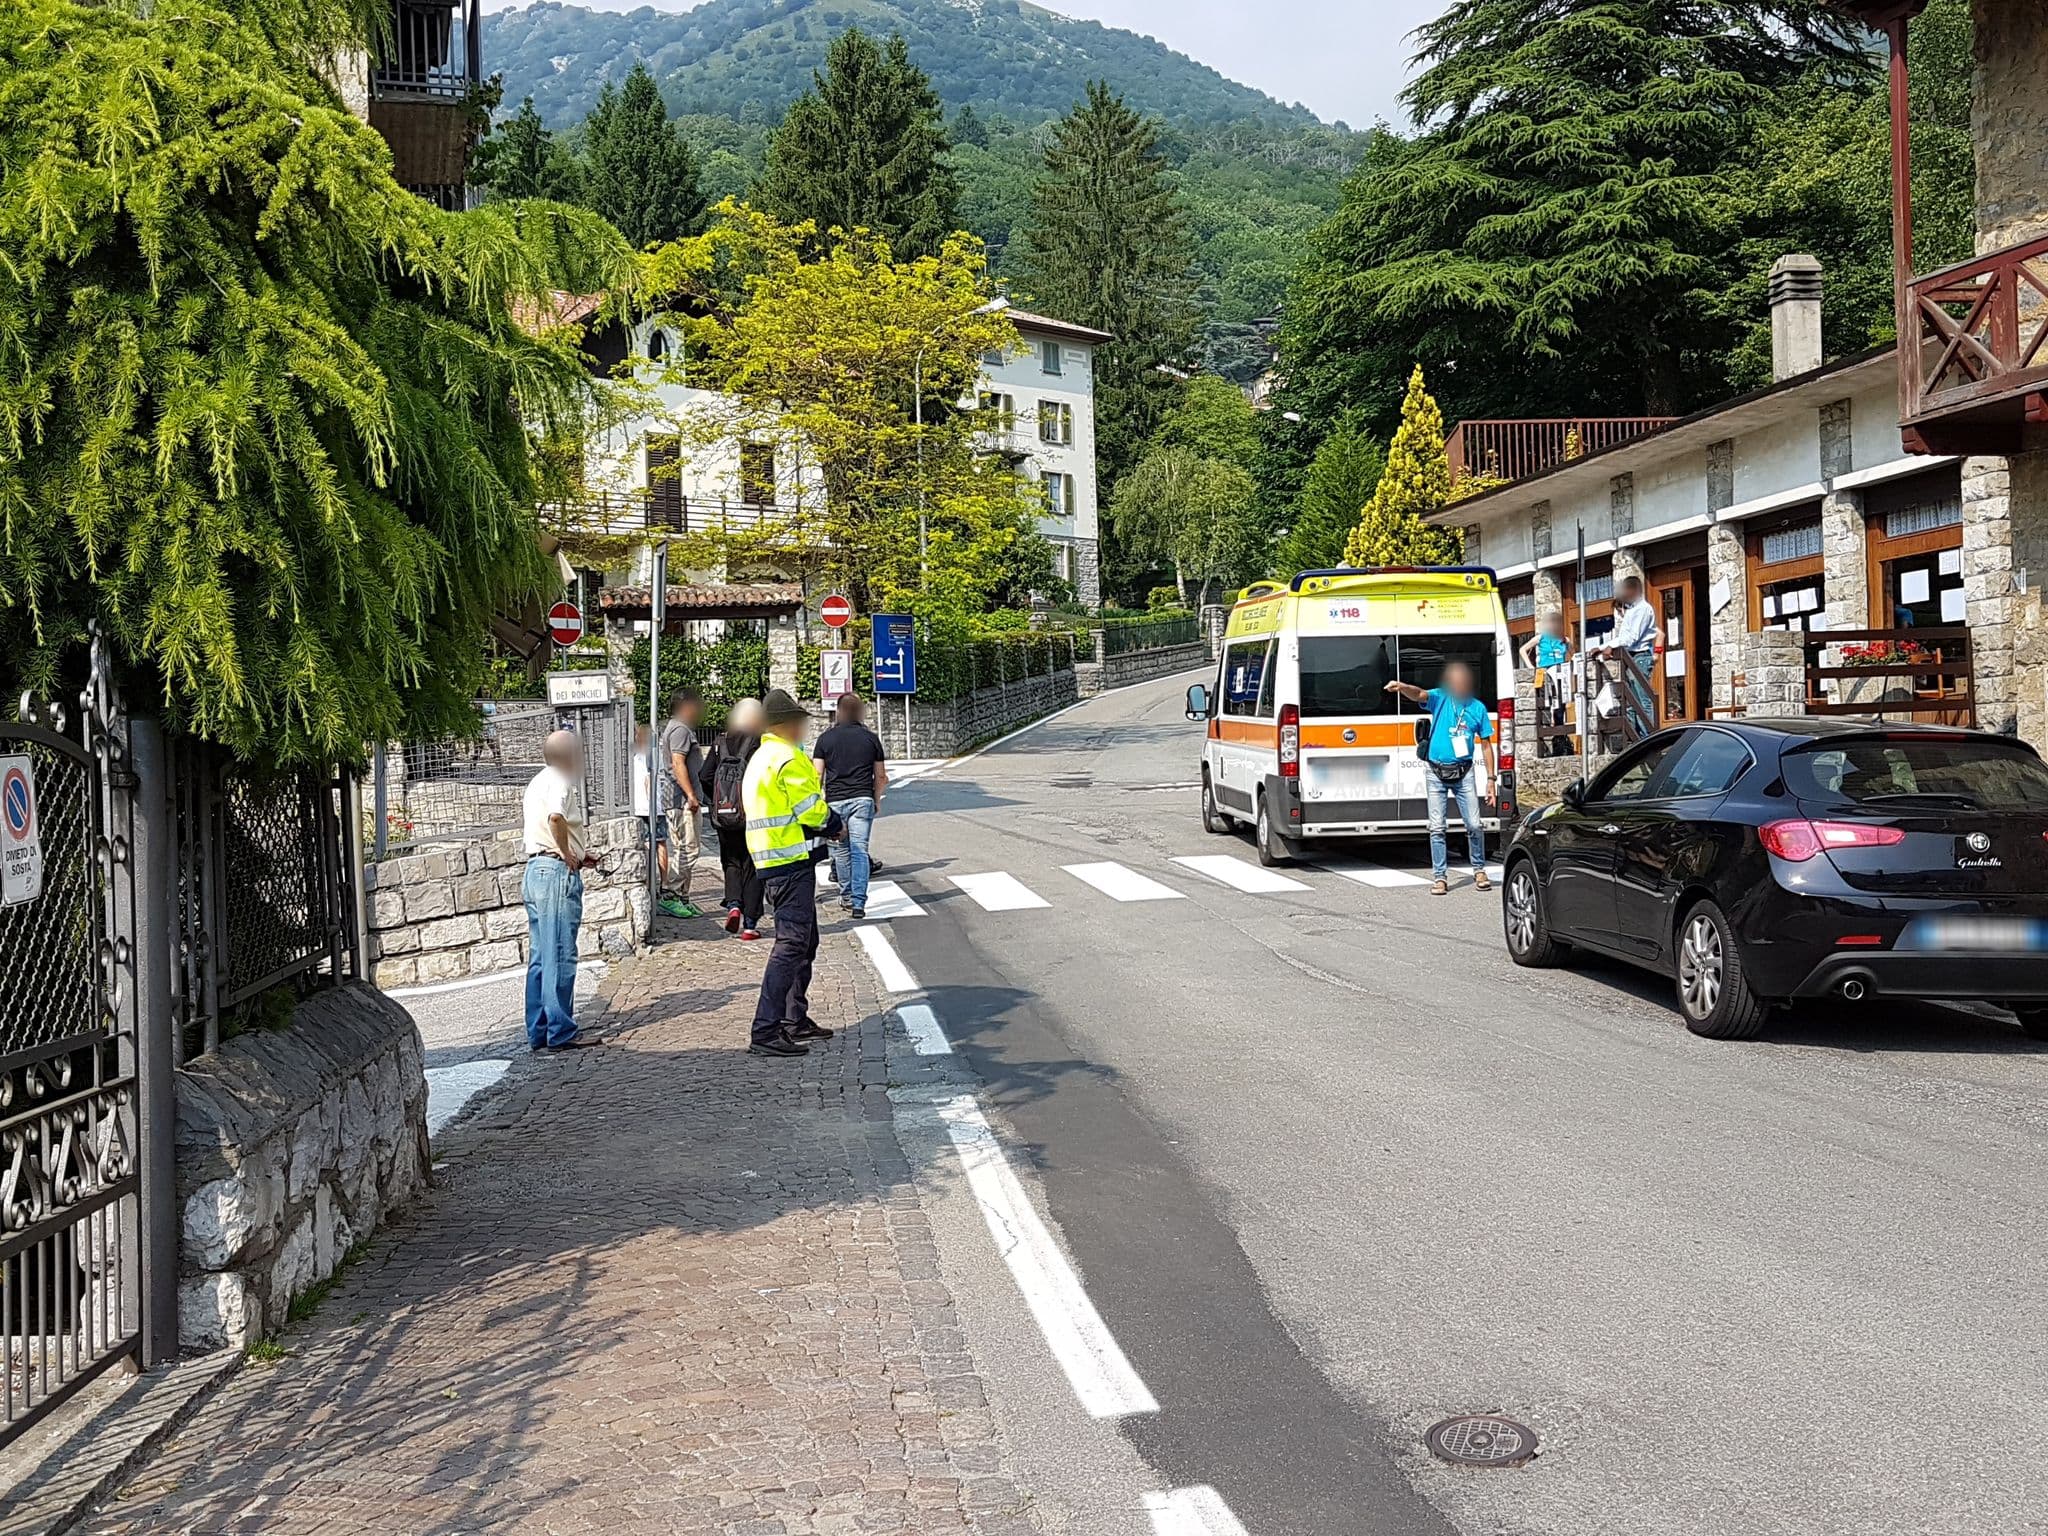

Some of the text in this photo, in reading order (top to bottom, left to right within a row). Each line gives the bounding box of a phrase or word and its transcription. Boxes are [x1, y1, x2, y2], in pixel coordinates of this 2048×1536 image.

[1339, 607, 1360, 619] 118
[556, 691, 567, 700] DEI
[5, 845, 37, 861] DIVIETO DI
[11, 862, 32, 876] SOSTA
[1957, 857, 2002, 869] Giulietta
